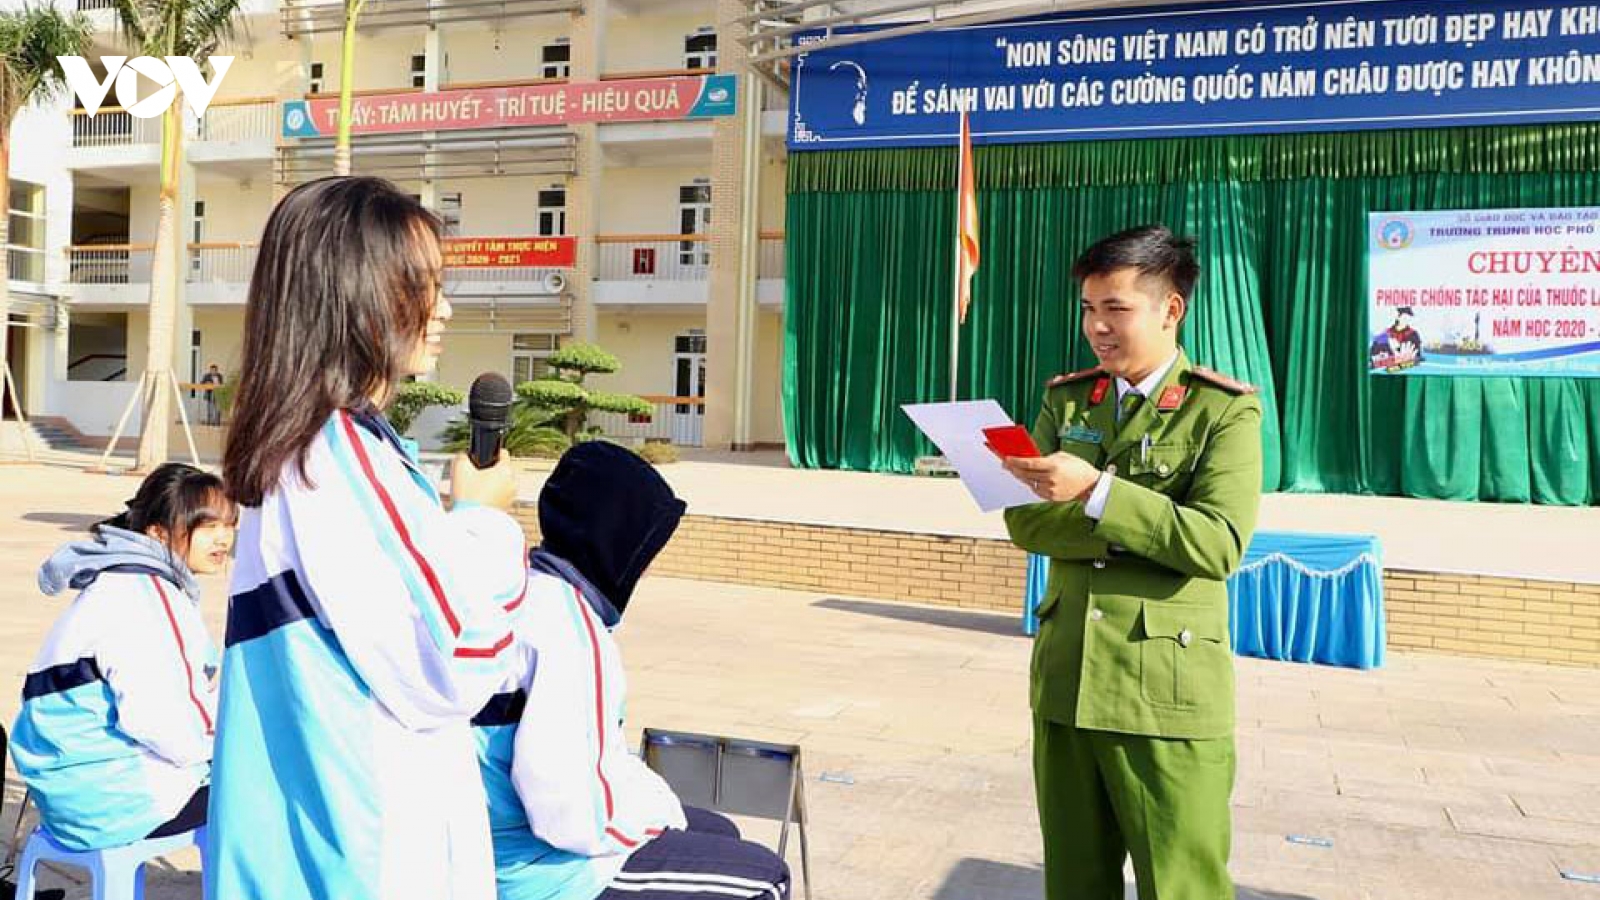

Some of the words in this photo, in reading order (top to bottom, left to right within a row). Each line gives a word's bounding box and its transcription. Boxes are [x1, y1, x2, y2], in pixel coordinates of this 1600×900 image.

[996, 38, 1051, 68] “NON
[1057, 34, 1115, 65] SÔNG
[1122, 30, 1168, 65] VIỆT
[1174, 31, 1227, 58] NAM
[1234, 23, 1266, 55] CÓ
[1272, 16, 1319, 53] TRỞ
[1324, 15, 1376, 50] NÊN
[1382, 14, 1438, 47] TƯƠI
[1444, 13, 1496, 49] ĐẸP
[1502, 9, 1553, 39] HAY
[1559, 6, 1600, 36] KH
[378, 100, 417, 125] TÂM
[421, 95, 482, 122] HUYẾT
[499, 92, 526, 117] TRÍ
[528, 89, 566, 120] TUỆ
[582, 87, 629, 119] HIỆU
[634, 82, 681, 112] QUẢ
[891, 80, 920, 115] ĐỂ
[922, 83, 978, 115] SÁNH
[984, 85, 1016, 111] VAI
[1021, 78, 1055, 109] VỚI
[1061, 76, 1104, 107] CÁC
[1111, 71, 1185, 105] CƯỜNG
[1192, 64, 1254, 104] QUỐC
[1260, 66, 1316, 98] NĂM
[1323, 61, 1389, 96] CHÂU
[1395, 61, 1463, 96] ĐƯỢC
[1471, 58, 1521, 89] HAY
[1467, 245, 1600, 274] CHUYÊN
[1554, 319, 1586, 338] 2020
